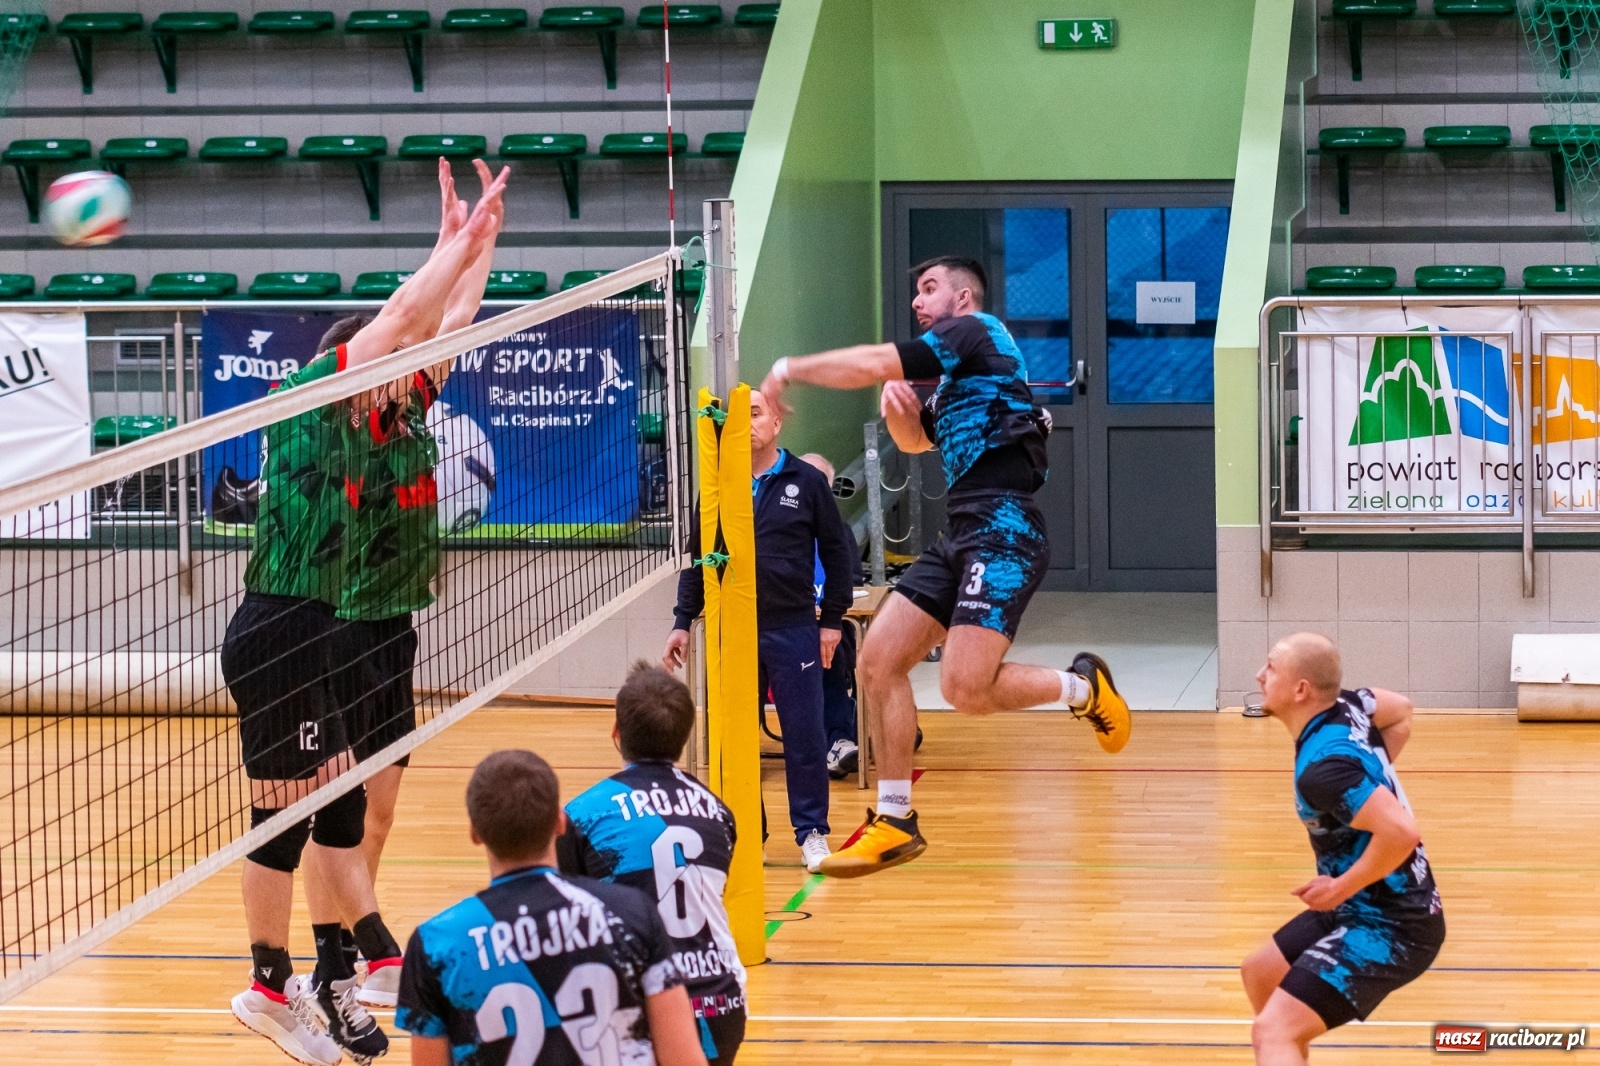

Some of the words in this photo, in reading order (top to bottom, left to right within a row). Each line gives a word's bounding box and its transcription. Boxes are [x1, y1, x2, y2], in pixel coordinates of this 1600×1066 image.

[493, 347, 593, 374] SPORT
[488, 384, 593, 407] Racibórz
[490, 414, 509, 427] ul.
[511, 414, 571, 430] Chopina
[574, 414, 592, 427] 17
[1346, 453, 1458, 490] powiat
[1346, 490, 1444, 509] zielona
[965, 561, 986, 595] 3
[299, 721, 319, 750] 12
[610, 781, 724, 822] TRÓJKA
[651, 825, 705, 938] 6
[467, 904, 614, 971] TRÓJKA
